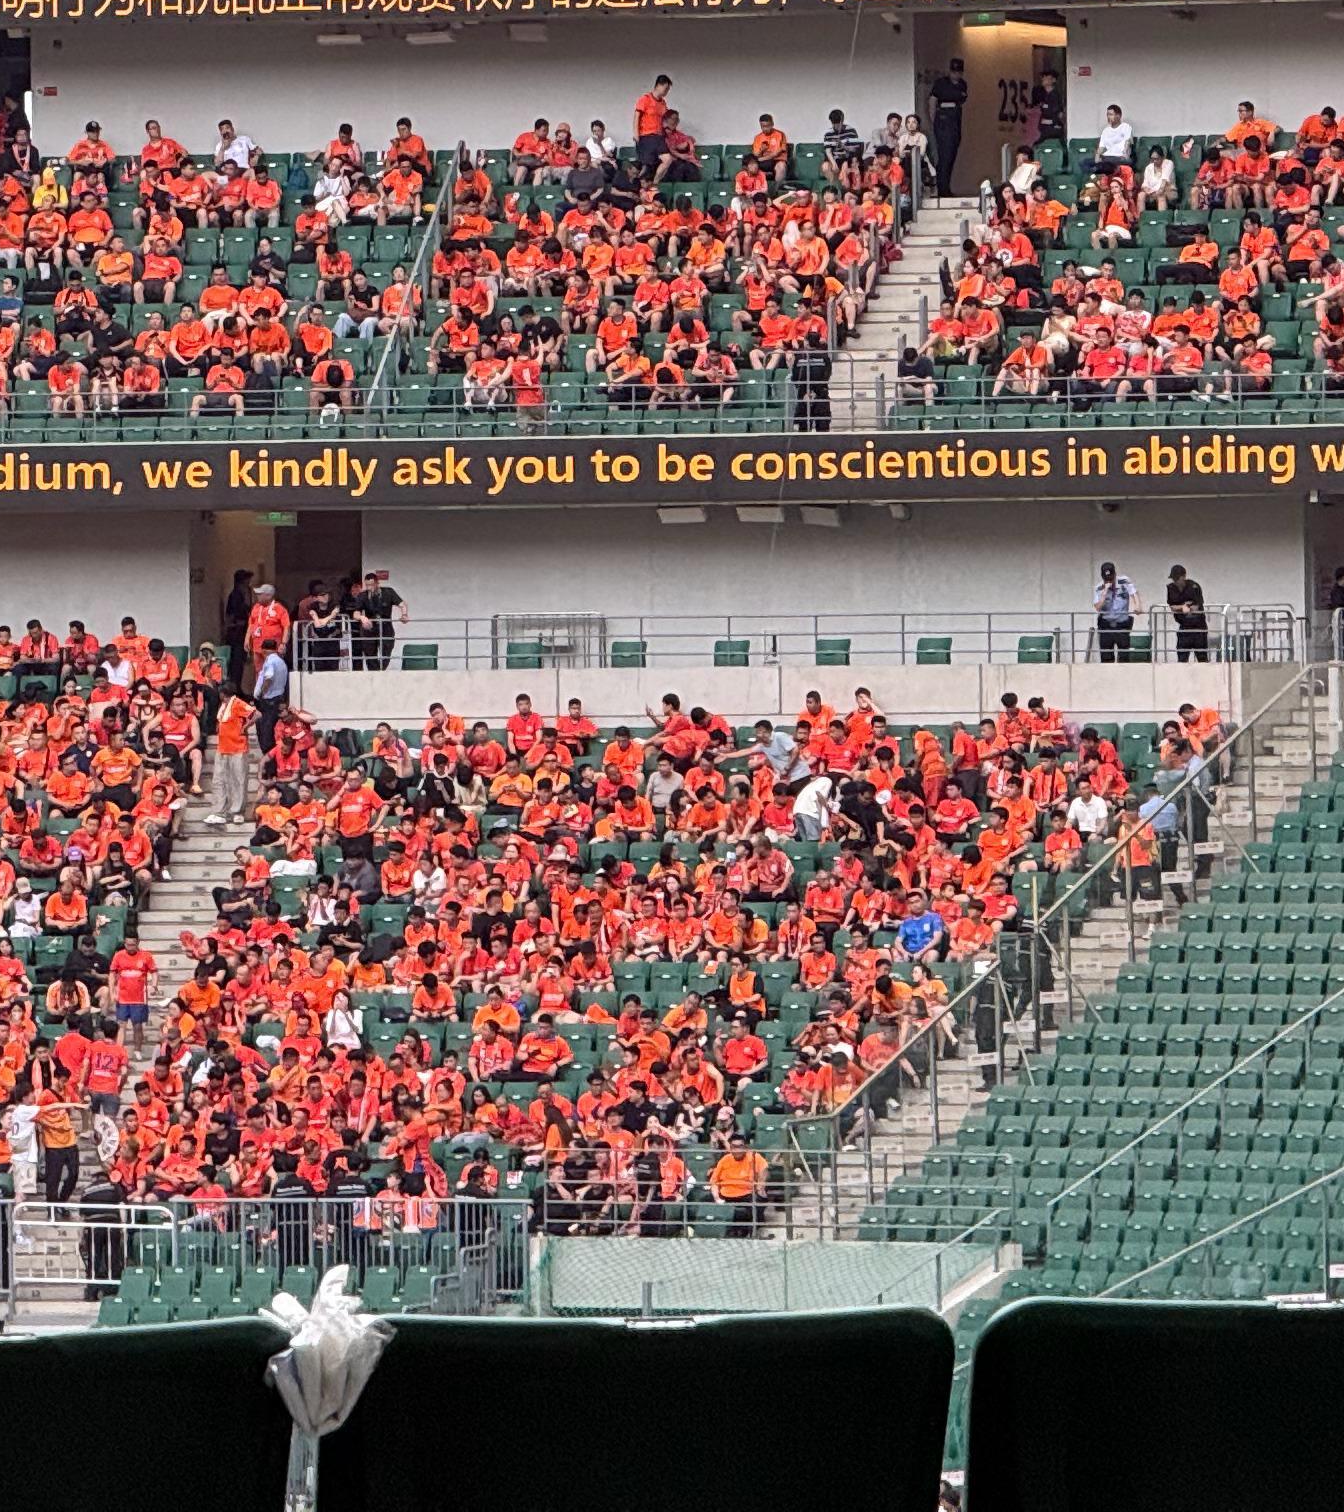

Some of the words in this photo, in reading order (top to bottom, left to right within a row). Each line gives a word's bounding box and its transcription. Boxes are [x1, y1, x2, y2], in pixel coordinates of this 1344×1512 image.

[143, 461, 213, 490] we
[229, 449, 378, 497] kindly
[392, 446, 471, 486] ask
[487, 456, 574, 495] you
[591, 450, 640, 483] to
[658, 443, 715, 482] be
[731, 440, 1051, 481] conscientious
[1067, 438, 1107, 475] in
[1123, 436, 1296, 485] abiding
